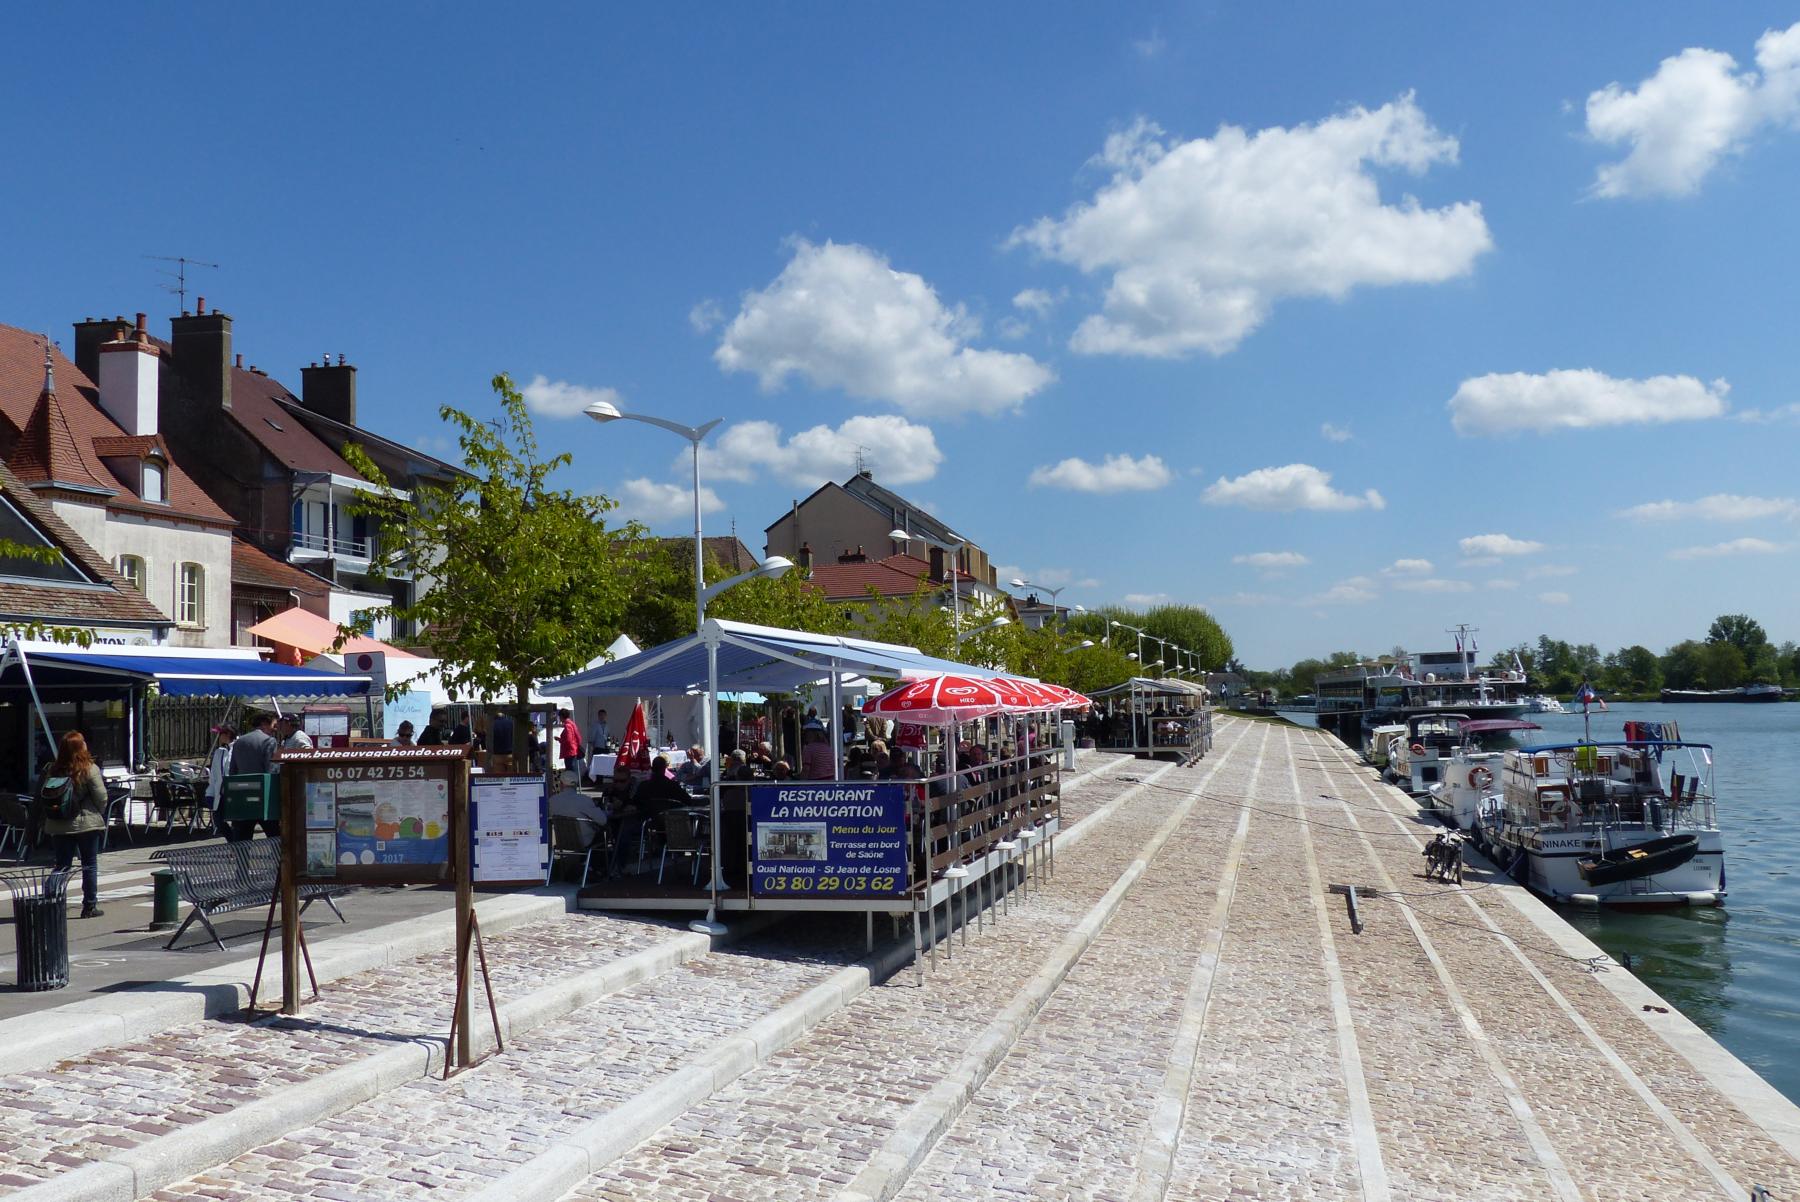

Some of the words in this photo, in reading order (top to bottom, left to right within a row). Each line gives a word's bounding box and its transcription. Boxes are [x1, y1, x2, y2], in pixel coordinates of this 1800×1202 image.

[280, 747, 463, 760] www.bateauvagabondo.com
[327, 768, 342, 779] 06
[347, 767, 362, 779] 07
[367, 767, 384, 778] 42
[388, 766, 404, 778] 75
[408, 766, 425, 777] 54
[778, 790, 875, 801] RESTAURANT
[771, 806, 789, 817] LA
[793, 805, 883, 817] NAVIGATION
[832, 825, 860, 834] Menu
[862, 824, 874, 834] du
[830, 841, 867, 849] Terrasse
[880, 841, 900, 849] bord
[1542, 839, 1580, 848] NINAKE
[382, 854, 404, 864] 2017
[845, 850, 857, 859] de
[757, 865, 777, 873] Quai
[779, 865, 816, 874] National
[824, 865, 835, 874] St
[836, 865, 858, 874] Jean
[859, 865, 871, 874] de
[873, 866, 901, 874] Losne
[764, 876, 787, 890] 03
[790, 876, 813, 890] 80
[817, 876, 840, 890] 29
[844, 876, 867, 890] 03
[870, 876, 895, 890] 62
